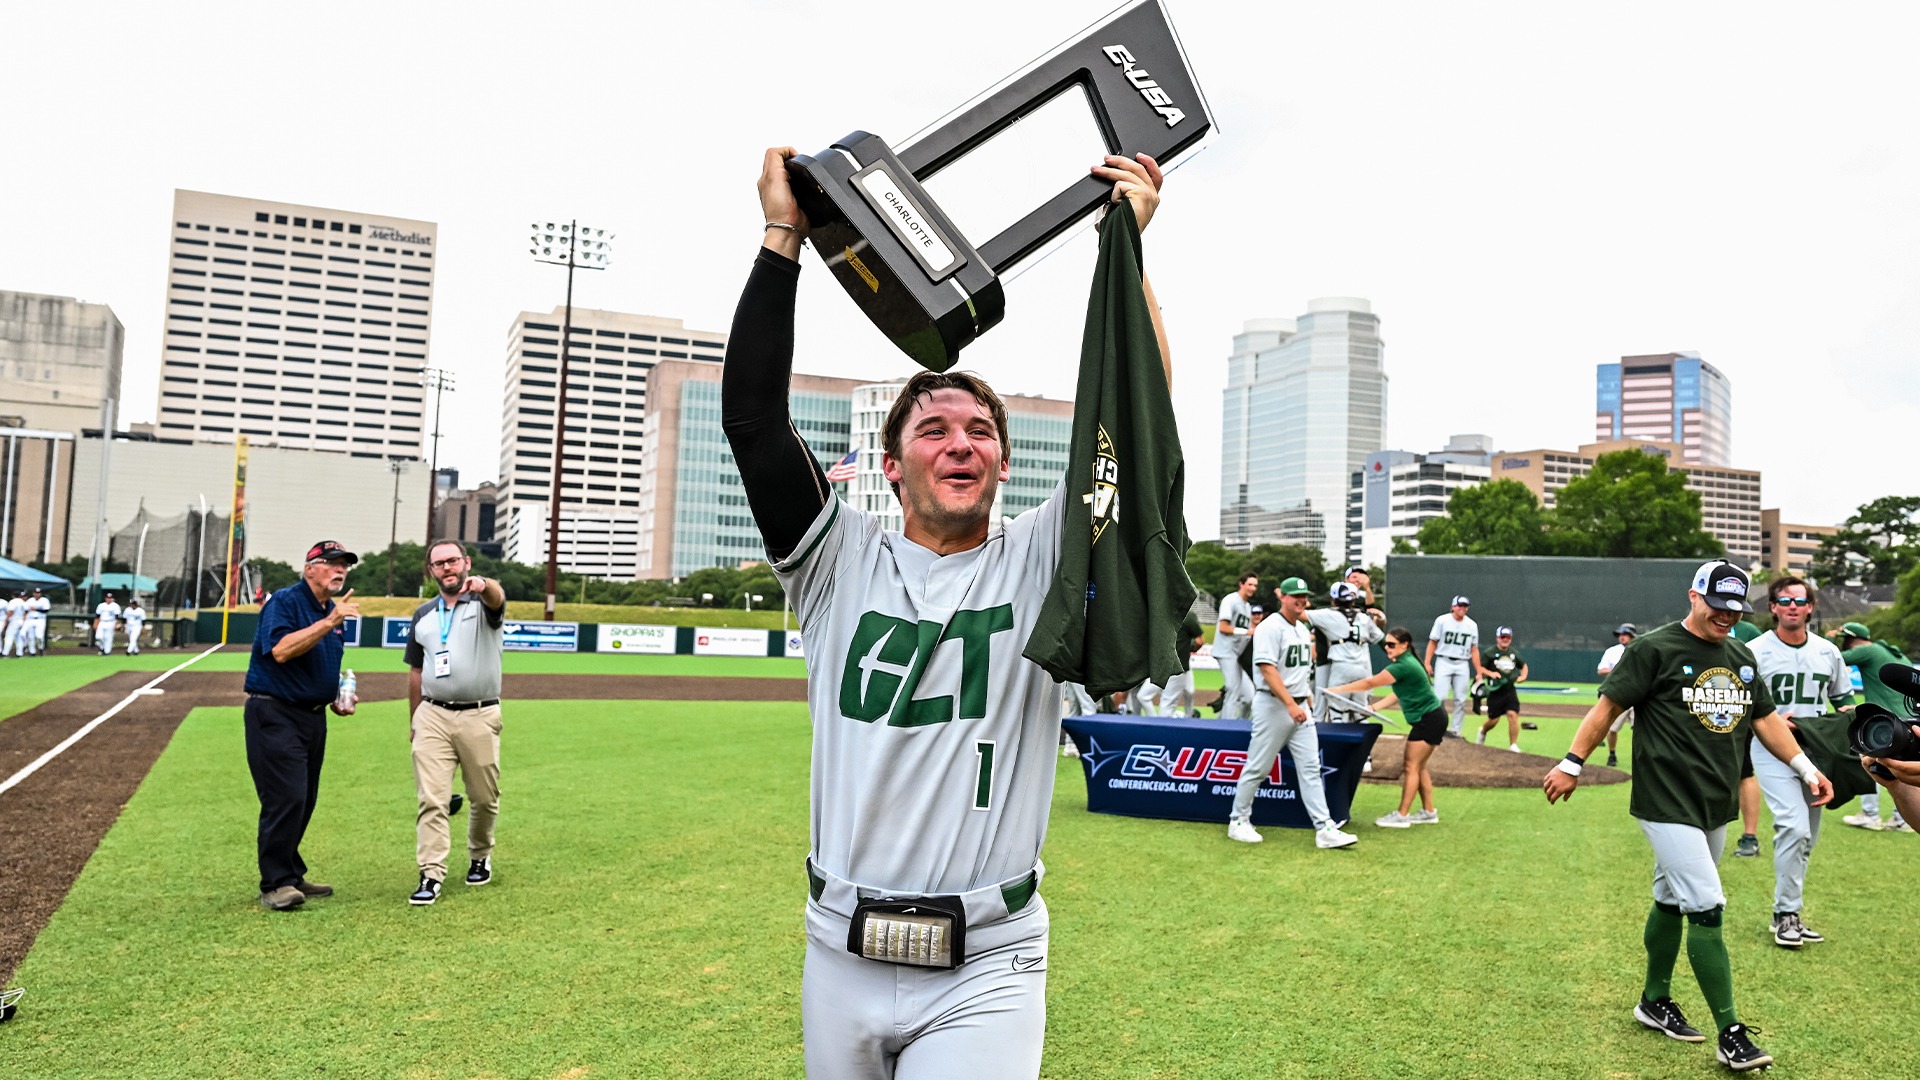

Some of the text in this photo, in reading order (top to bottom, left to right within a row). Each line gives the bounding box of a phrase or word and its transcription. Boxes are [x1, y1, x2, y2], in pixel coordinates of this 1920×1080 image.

[884, 191, 934, 248] CHARLOTTE
[368, 230, 431, 245] Methodist
[1502, 458, 1530, 470] Hilton
[1444, 631, 1471, 646] CLT
[838, 602, 1014, 728] CLT
[1682, 687, 1753, 705] BASEBALL
[1771, 672, 1830, 705] CLT
[1692, 702, 1744, 715] CHAMPIONS
[972, 739, 996, 811] 1
[1108, 778, 1296, 799] CONFERENCEUSA.COM @CONENCEUSA
